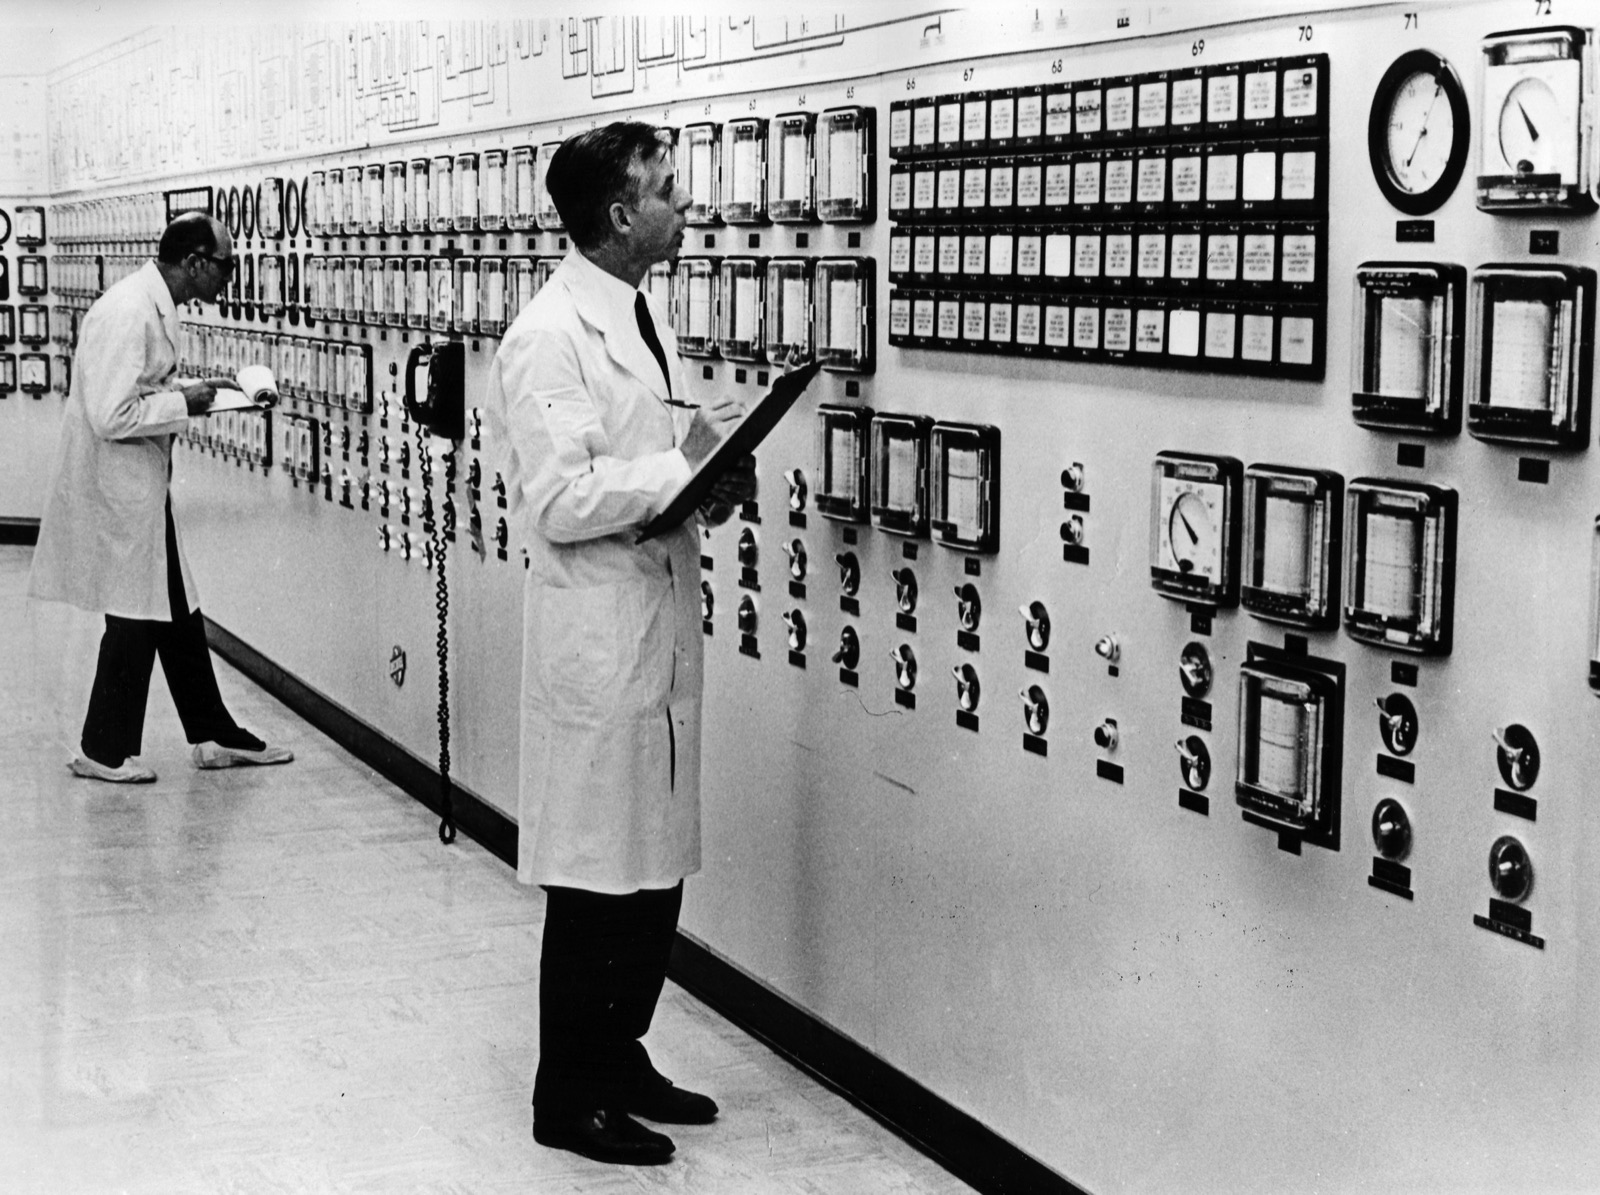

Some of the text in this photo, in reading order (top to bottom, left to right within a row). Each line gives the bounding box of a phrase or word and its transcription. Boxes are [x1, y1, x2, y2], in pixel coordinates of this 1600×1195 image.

[1404, 13, 1418, 29] 71
[1299, 25, 1313, 41] 70
[1191, 39, 1205, 57] 69
[1052, 59, 1062, 74] 68
[963, 68, 974, 81] 67
[906, 78, 916, 91] 66
[846, 86, 855, 99] 65
[798, 95, 806, 106] 64
